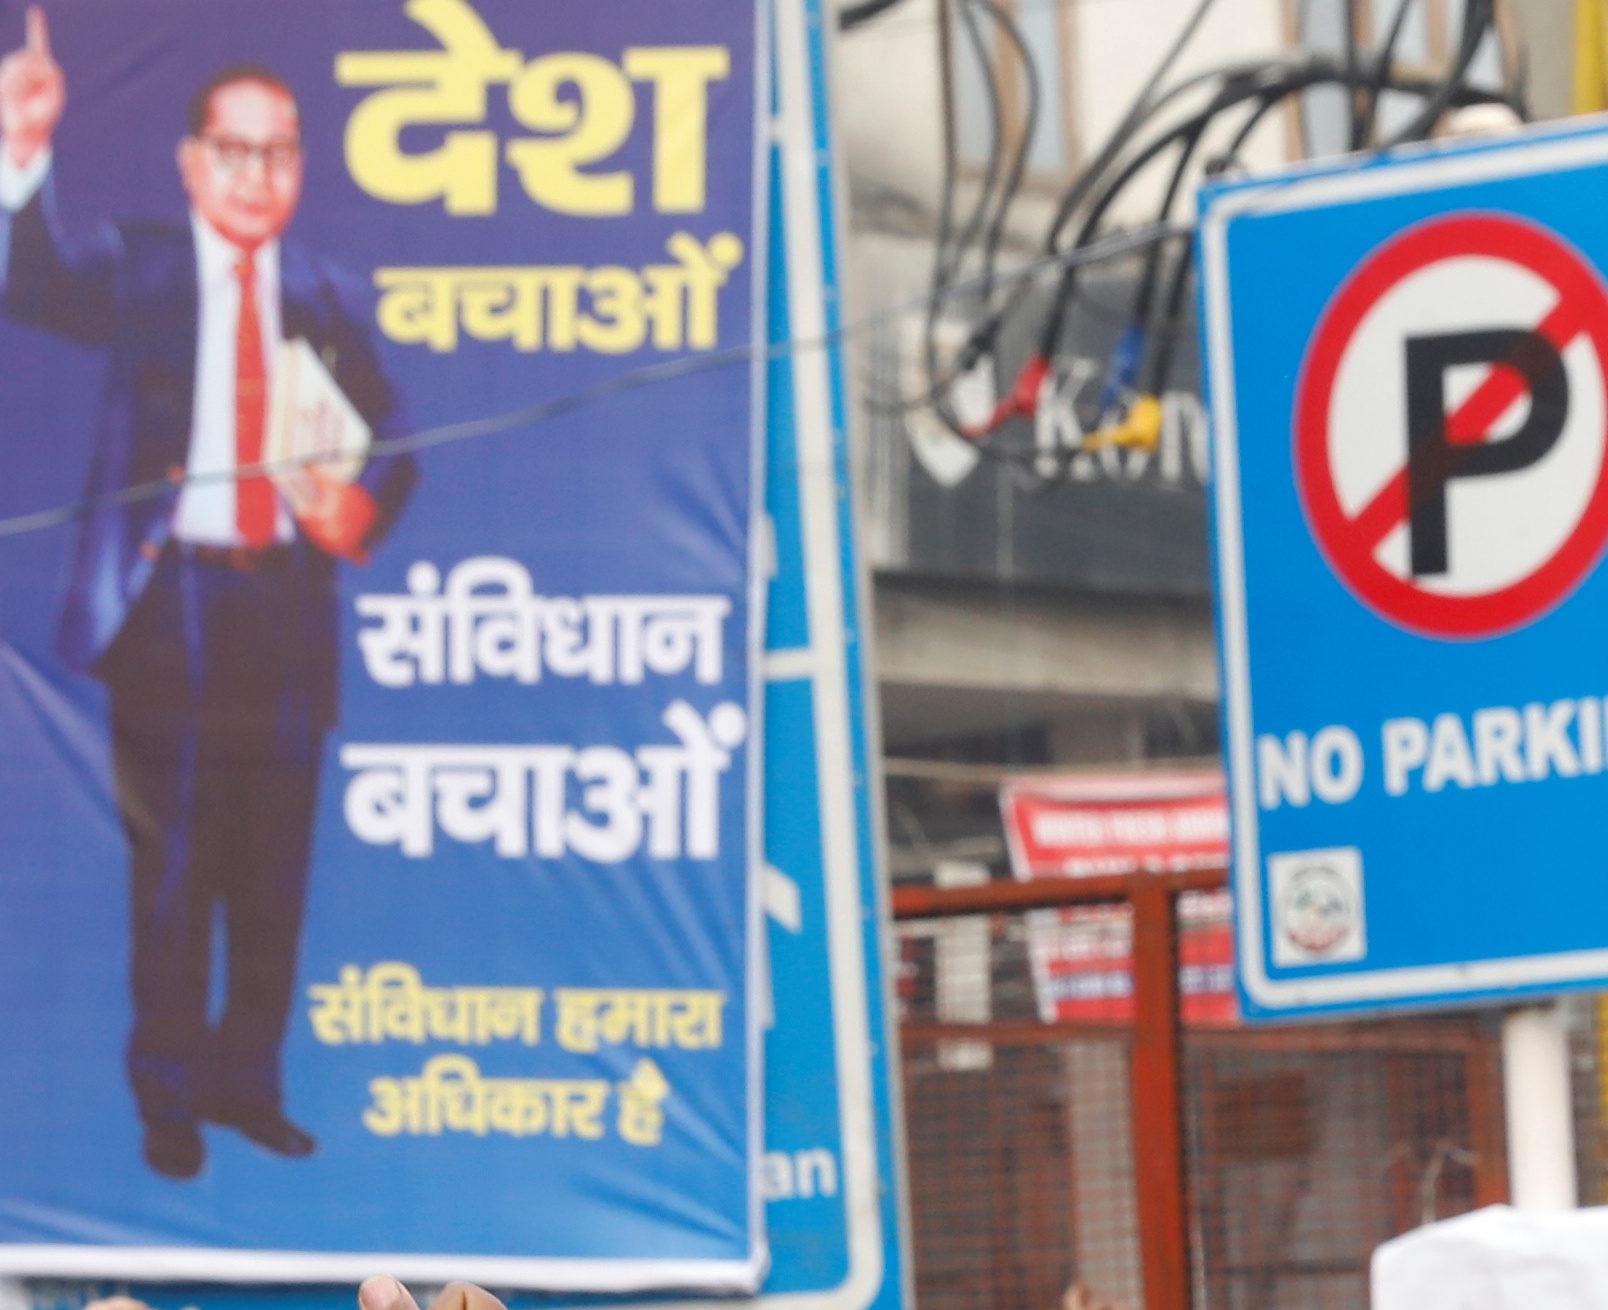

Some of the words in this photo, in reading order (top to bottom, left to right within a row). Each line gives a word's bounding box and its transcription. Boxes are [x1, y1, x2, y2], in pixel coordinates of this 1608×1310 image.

[335, 0, 730, 217] देश
[374, 232, 744, 354] बचाओं
[356, 556, 731, 688] संविधान
[340, 698, 747, 862] बचाओं
[1256, 725, 1364, 811] NO
[308, 961, 543, 1046] संविधान
[554, 985, 726, 1052] हमारा
[362, 1053, 611, 1140] अधिकार
[616, 1056, 671, 1146] है
